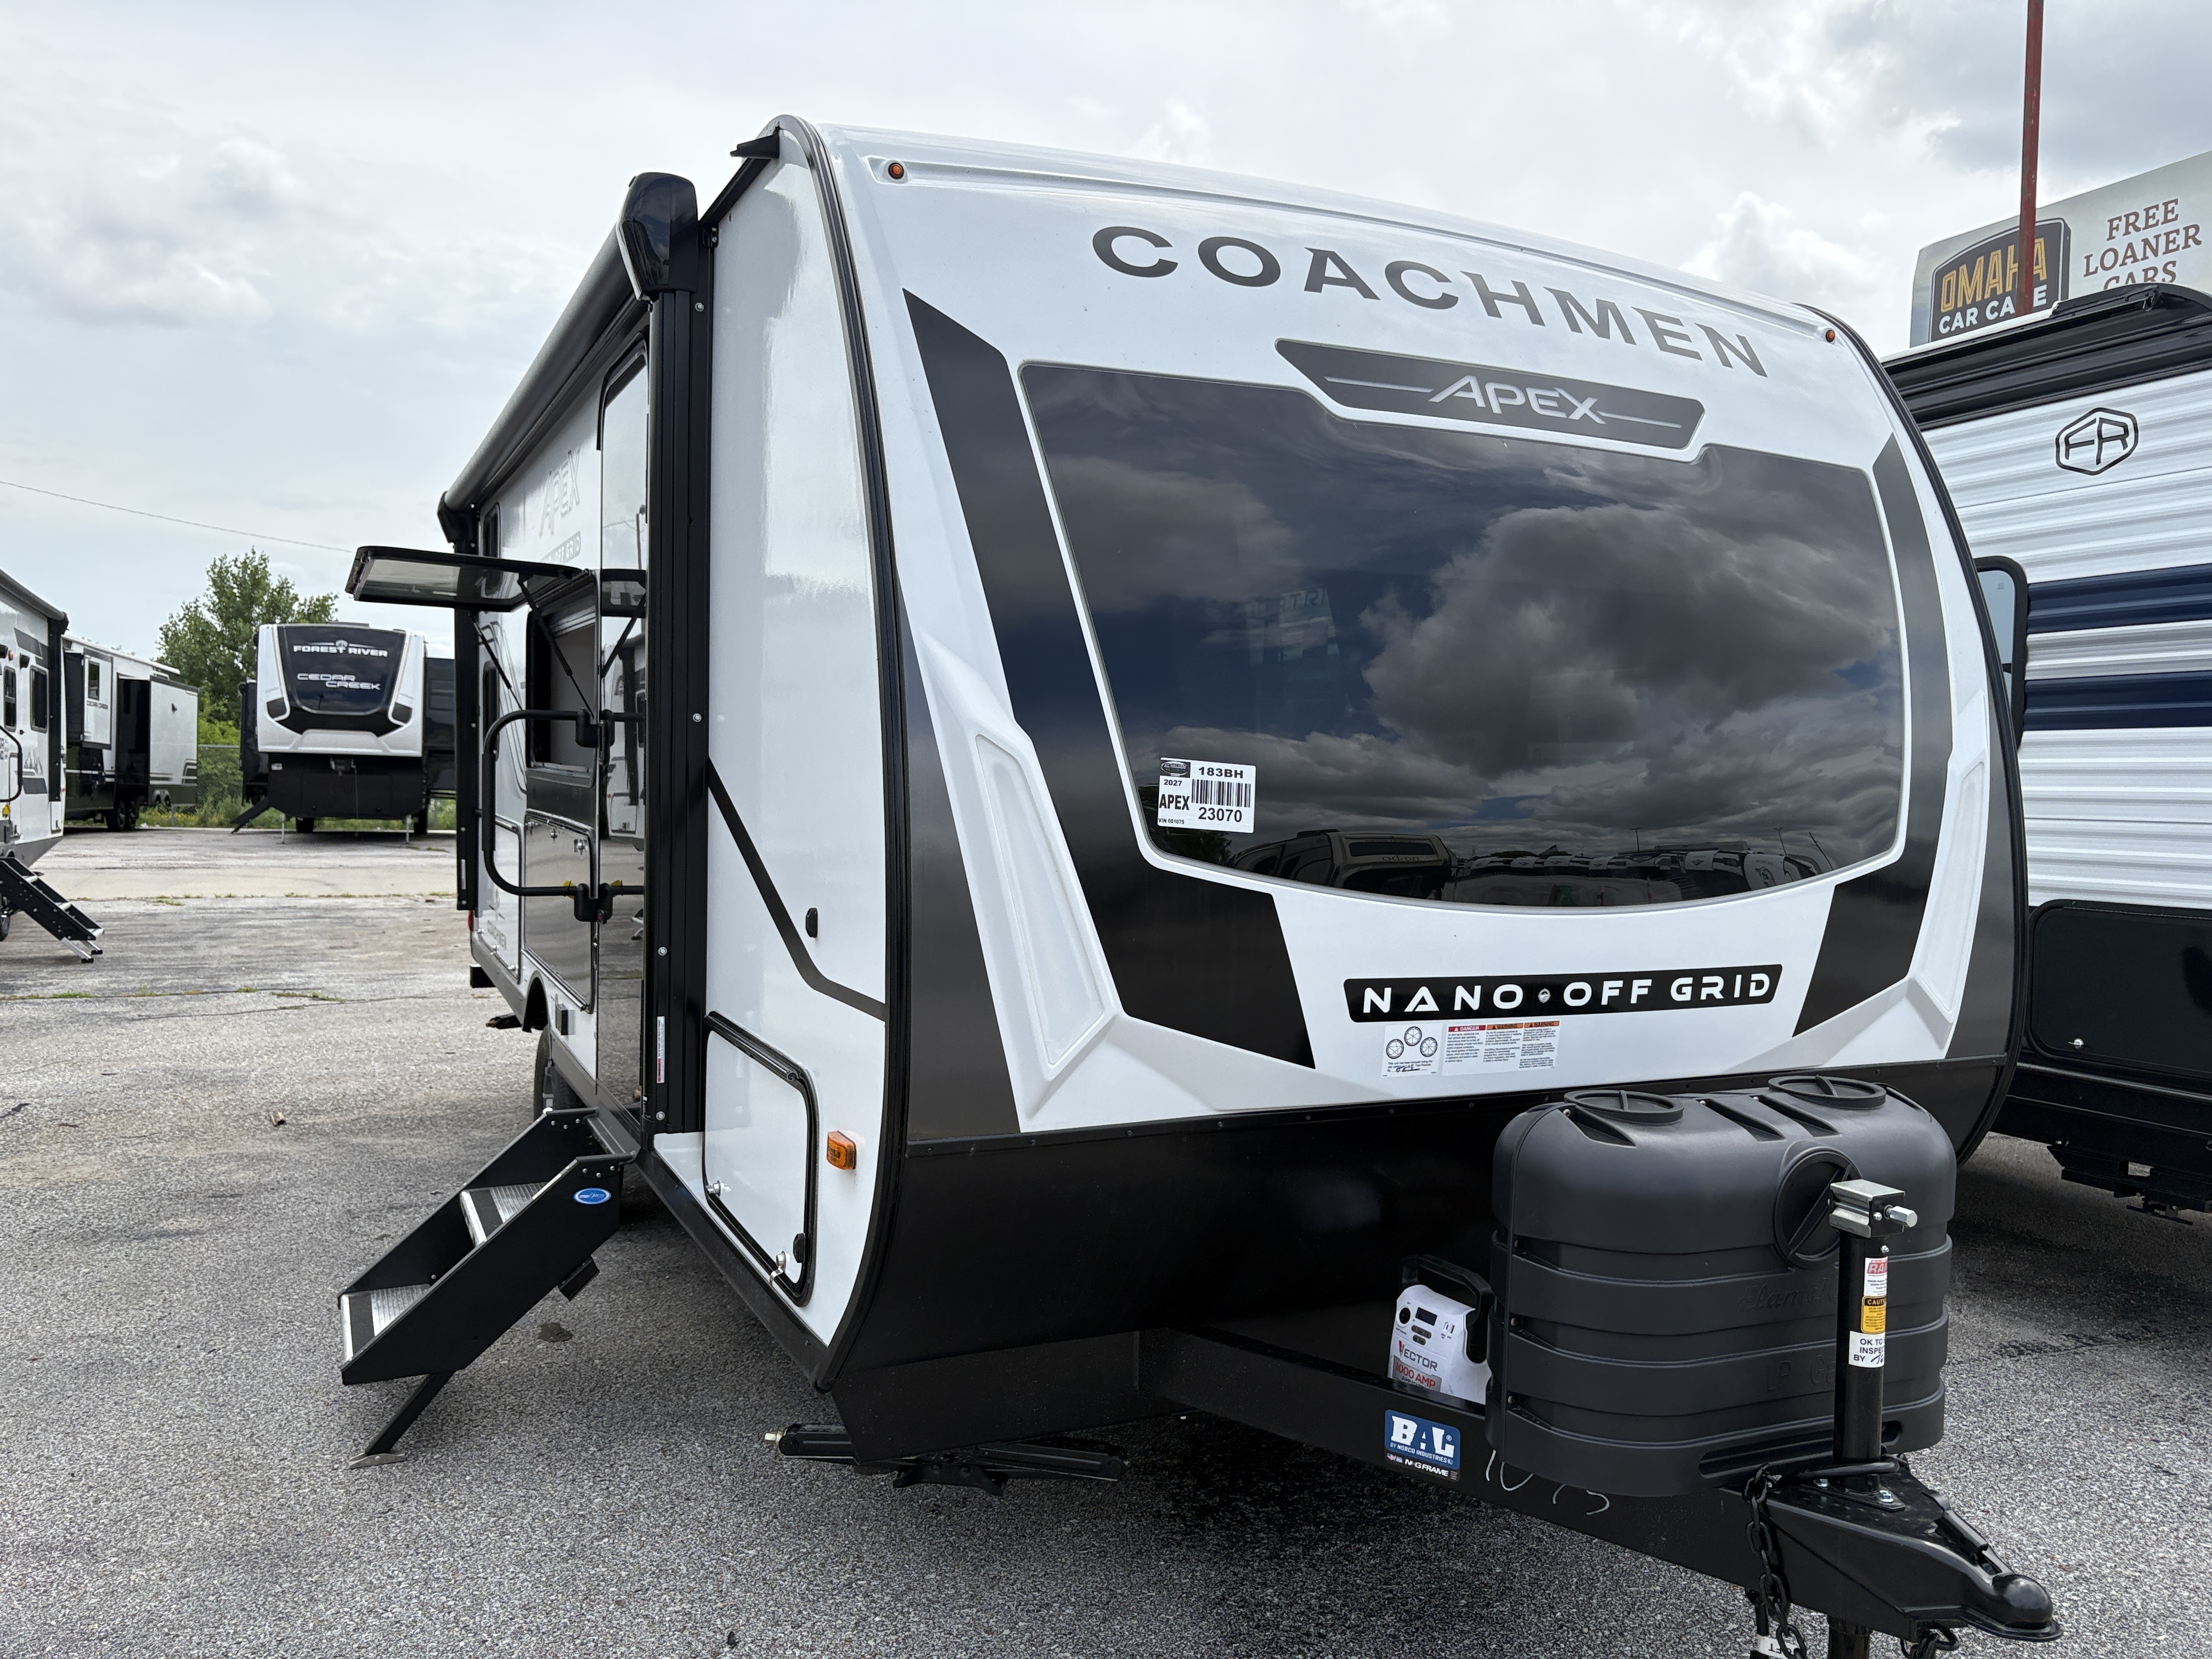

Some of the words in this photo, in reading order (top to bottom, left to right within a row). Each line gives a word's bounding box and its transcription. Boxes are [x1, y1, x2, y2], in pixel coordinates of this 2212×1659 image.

[2106, 198, 2179, 241] FREE
[2084, 224, 2202, 278] LOANER
[1092, 226, 1768, 377] COACHMEN
[1939, 307, 1978, 334] CAR
[1985, 284, 2047, 320] CAE
[1428, 375, 1607, 424] APEX
[294, 645, 346, 654] FOREST
[348, 647, 388, 657] RIVER
[297, 673, 356, 681] CEDAR
[325, 681, 381, 691] CREEK
[1198, 767, 1243, 778] 183BH
[1159, 794, 1190, 810] APEX
[1198, 807, 1242, 822] 23070
[1363, 984, 1525, 1014] NANO
[1563, 979, 1652, 1006] OFF
[1670, 973, 1770, 1002] GRID
[1398, 1340, 1438, 1372] VECTOR
[1396, 1362, 1414, 1379] 1000
[1415, 1373, 1436, 1388] AMP
[1391, 1415, 1455, 1458] BAL
[1397, 1444, 1415, 1454] NORCO
[1416, 1449, 1447, 1463] INDUSTRIES
[1422, 1464, 1449, 1477] FRAME
